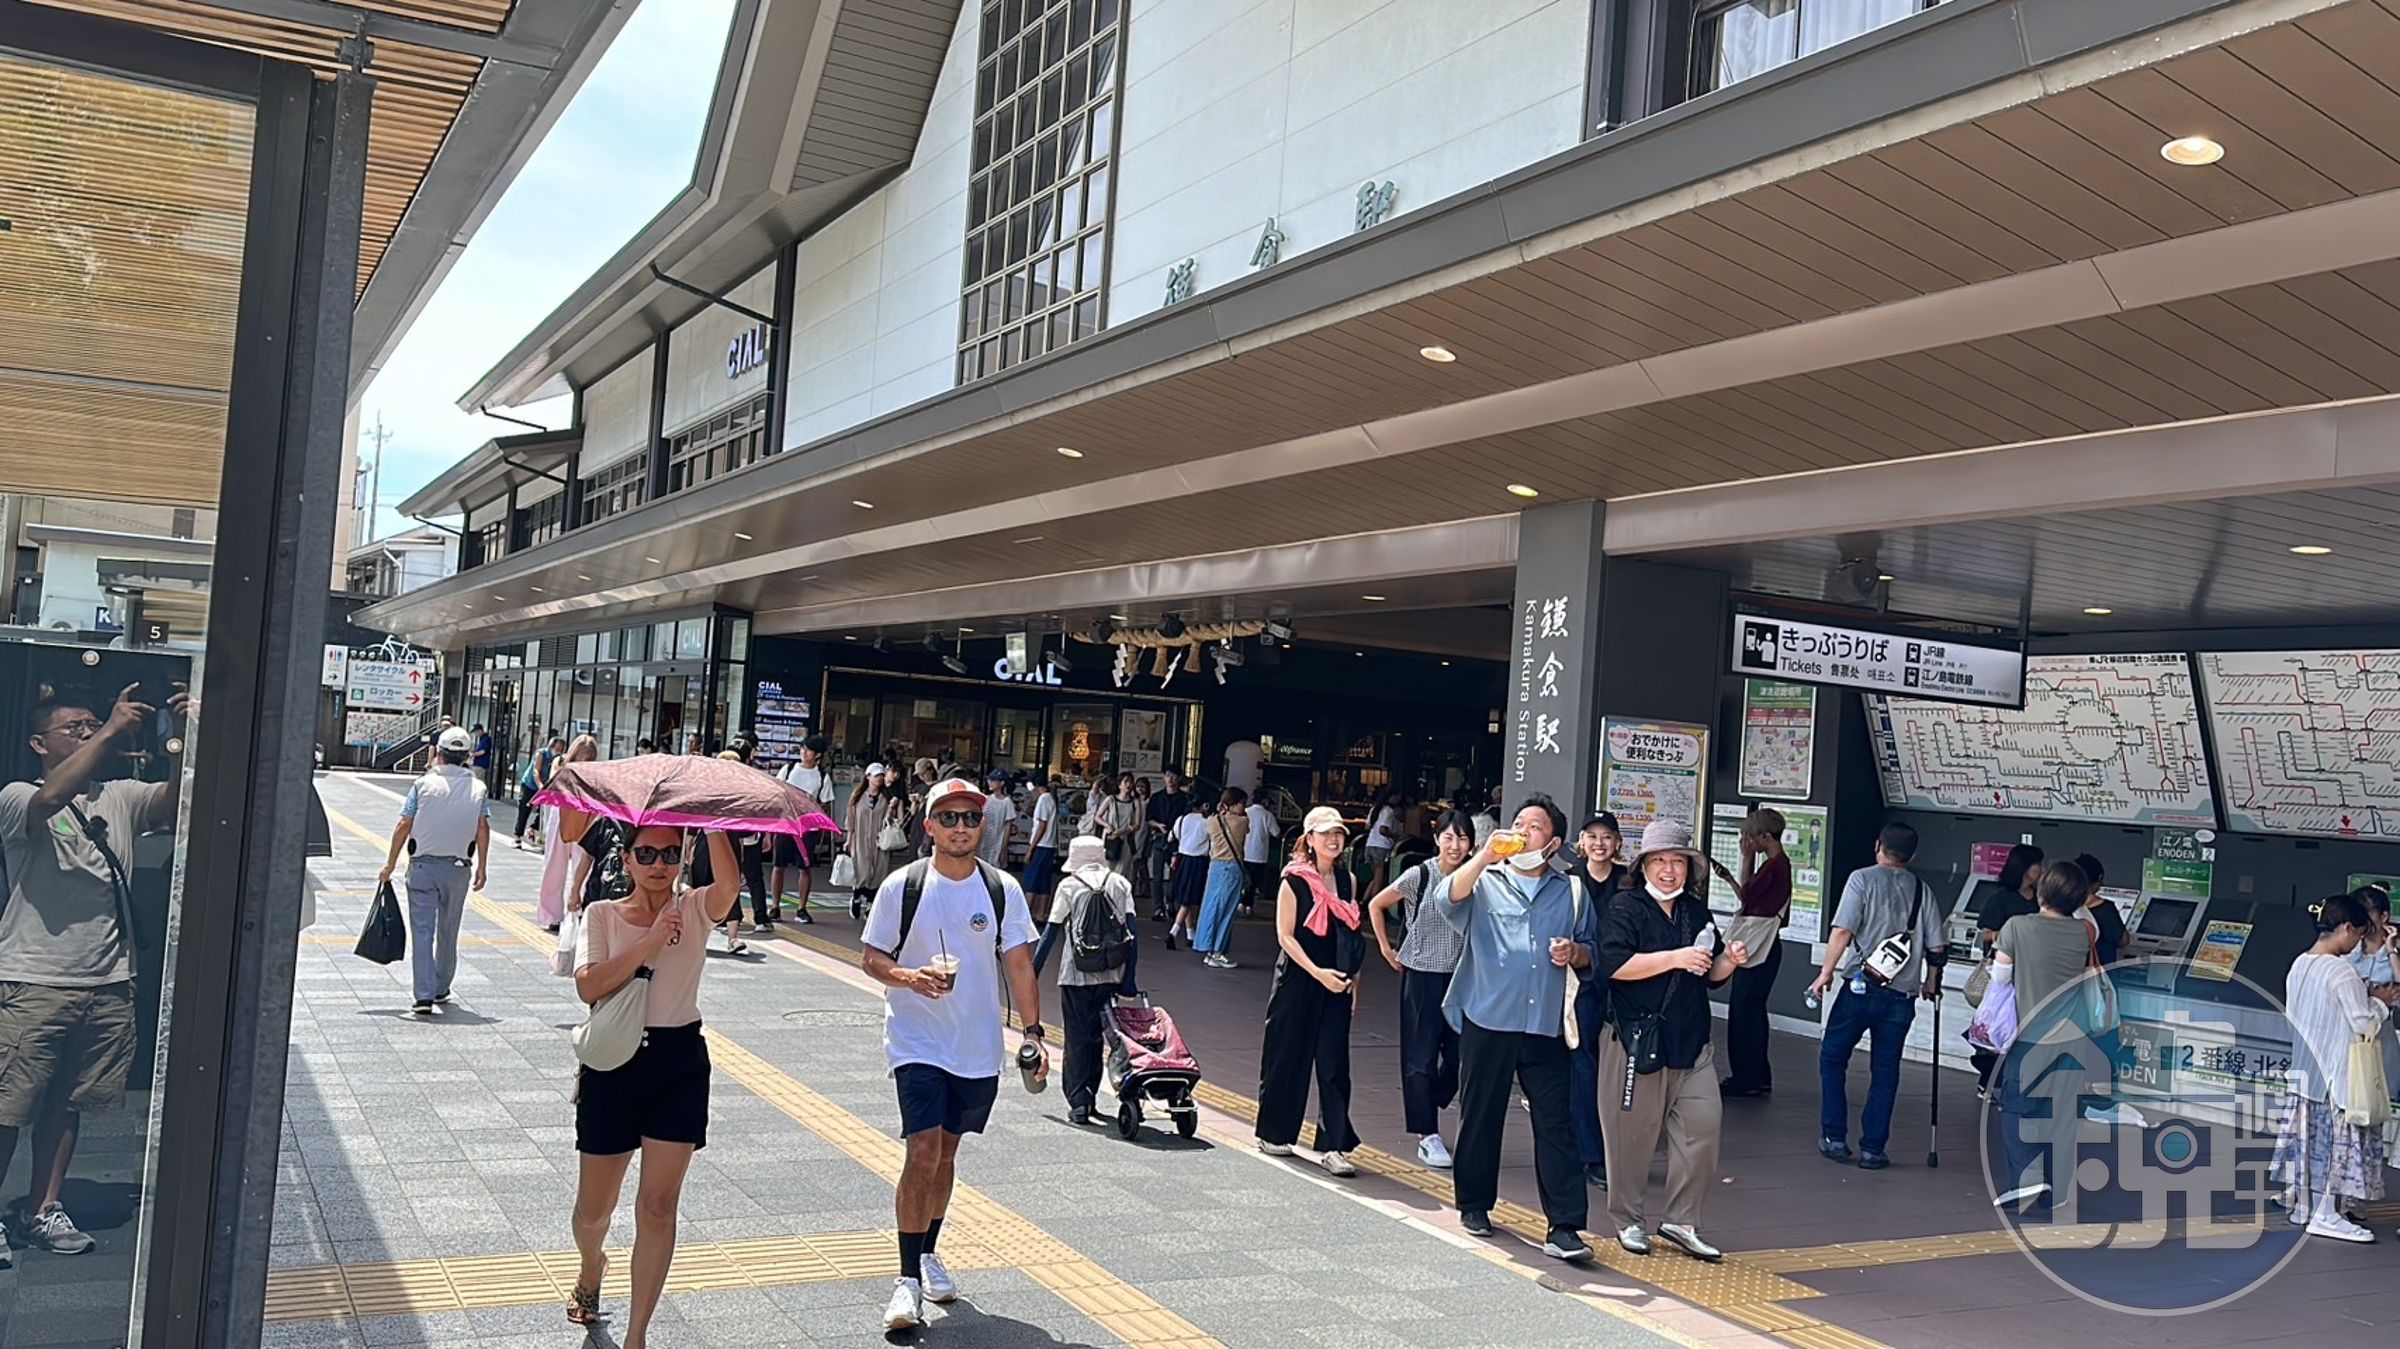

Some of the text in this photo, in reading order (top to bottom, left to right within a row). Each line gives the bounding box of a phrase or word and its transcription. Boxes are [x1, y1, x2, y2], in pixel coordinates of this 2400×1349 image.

[726, 324, 764, 379] CIAL
[150, 626, 161, 638] 5
[683, 627, 701, 650] CIAL
[1782, 628, 1890, 662] きっぷうりば
[993, 657, 1062, 685] CAL
[1780, 657, 1822, 675] Tickets
[1867, 668, 1896, 682] 매표소
[758, 681, 782, 691] CIAL
[1515, 599, 1537, 782] Kamakura Station
[1631, 733, 1681, 748] おでかけに
[1626, 746, 1684, 762] 便利なきっぷ
[2162, 836, 2193, 848] 江ノ電
[2158, 848, 2196, 859] ENODEN
